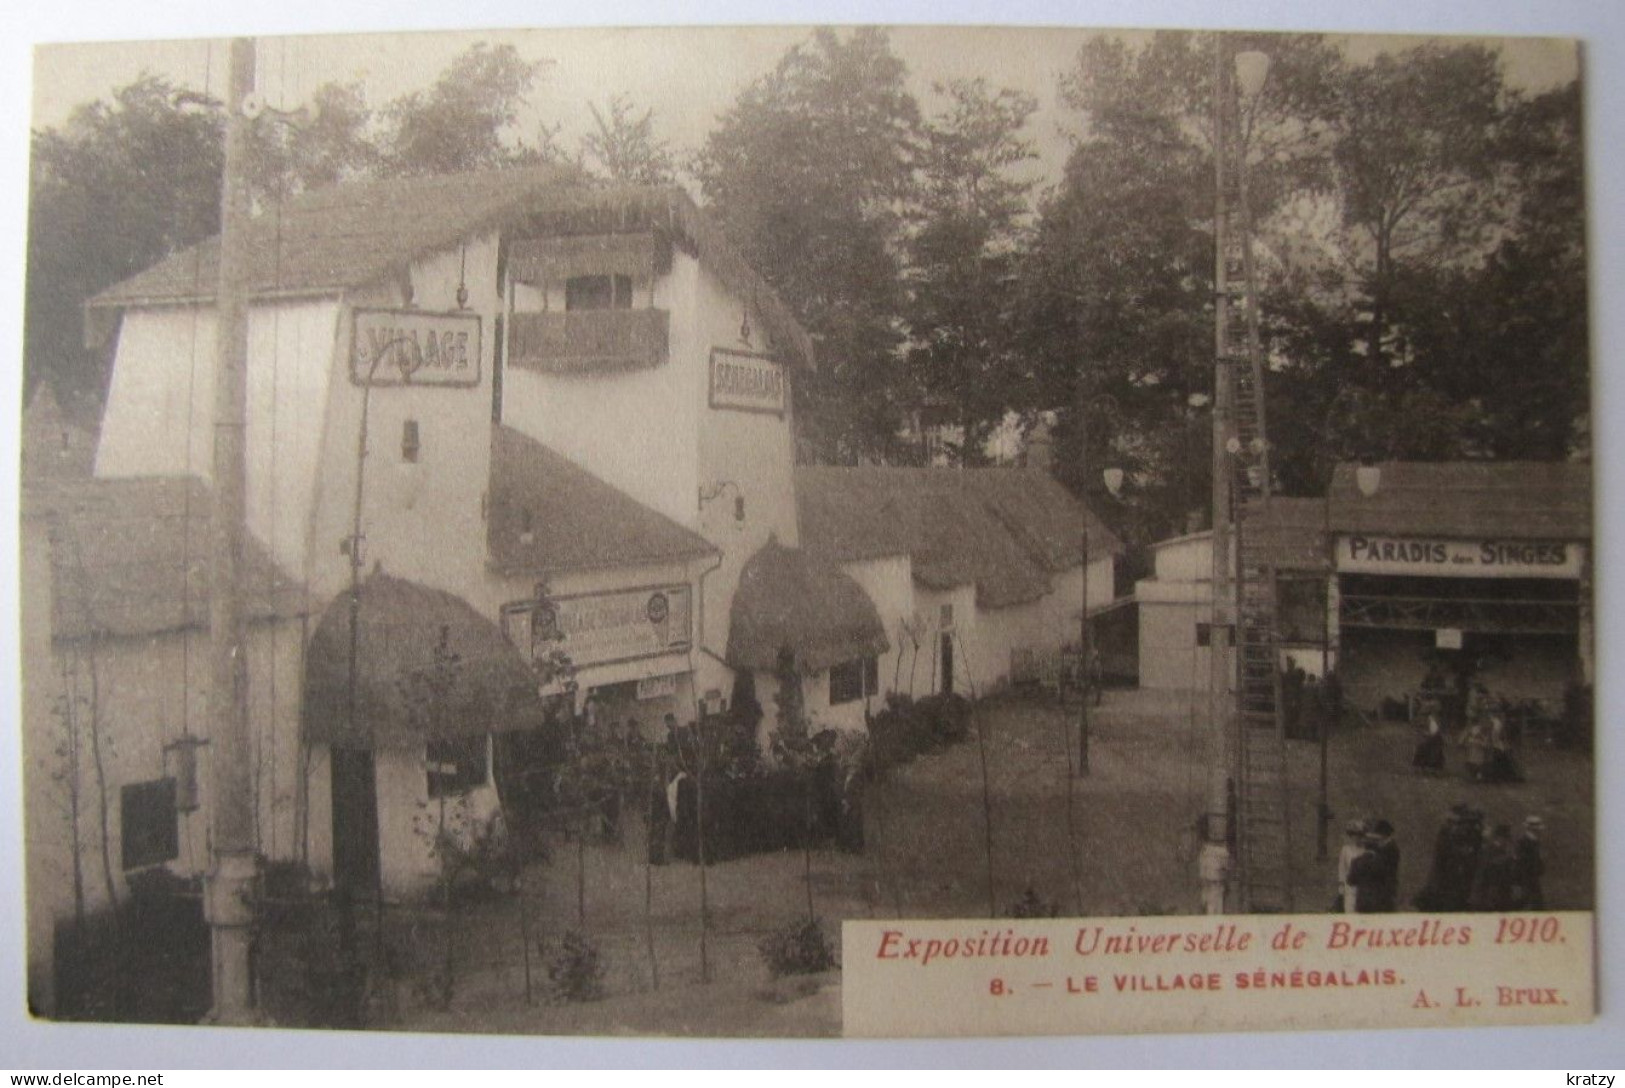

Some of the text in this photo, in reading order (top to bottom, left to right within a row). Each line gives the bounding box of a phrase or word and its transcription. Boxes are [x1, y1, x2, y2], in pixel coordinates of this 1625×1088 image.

[366, 327, 469, 370] VILLAGE
[1350, 537, 1447, 564] PARADIS
[1480, 541, 1567, 566] SINGES
[876, 916, 1567, 966] Exposition Universelle de Bruxelles 1910.
[989, 977, 1014, 997] 8.
[1066, 976, 1099, 994] LE
[1114, 972, 1222, 992] VILLAGE
[1235, 967, 1406, 989] SÉNÉGALAIS.
[1411, 985, 1568, 1010] A. L. Brux.
